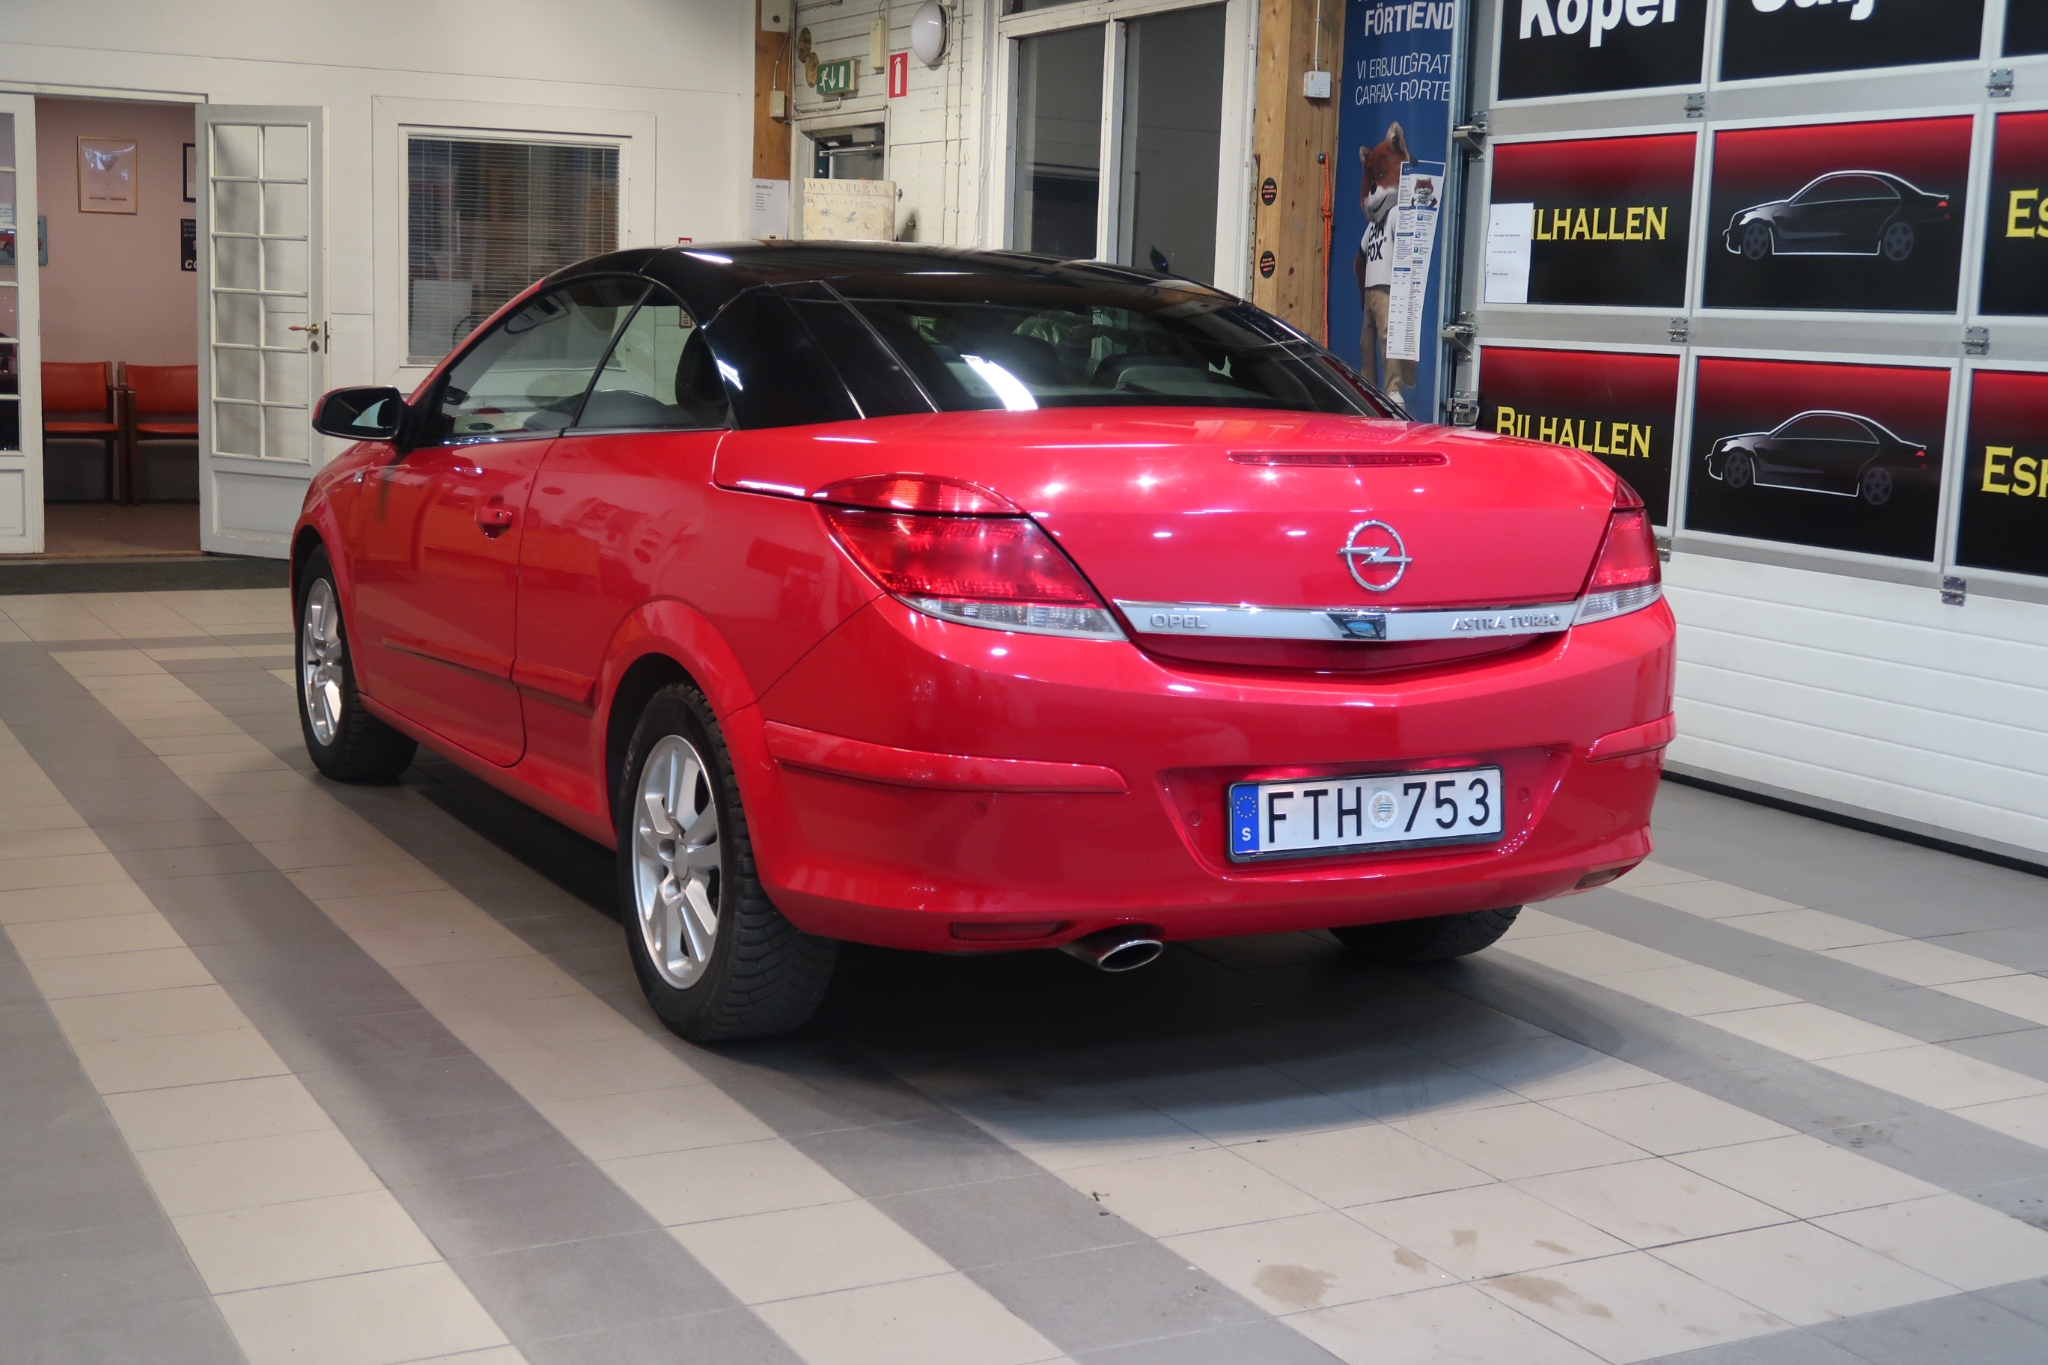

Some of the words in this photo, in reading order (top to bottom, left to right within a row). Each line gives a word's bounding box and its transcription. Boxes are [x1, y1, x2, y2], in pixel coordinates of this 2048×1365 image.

[1150, 613, 1208, 629] OPEL
[1451, 617, 1507, 631] ASTRA
[1509, 613, 1561, 629] TURBO
[1268, 786, 1362, 843] FTH
[1403, 778, 1490, 832] 753
[1241, 827, 1251, 841] S
